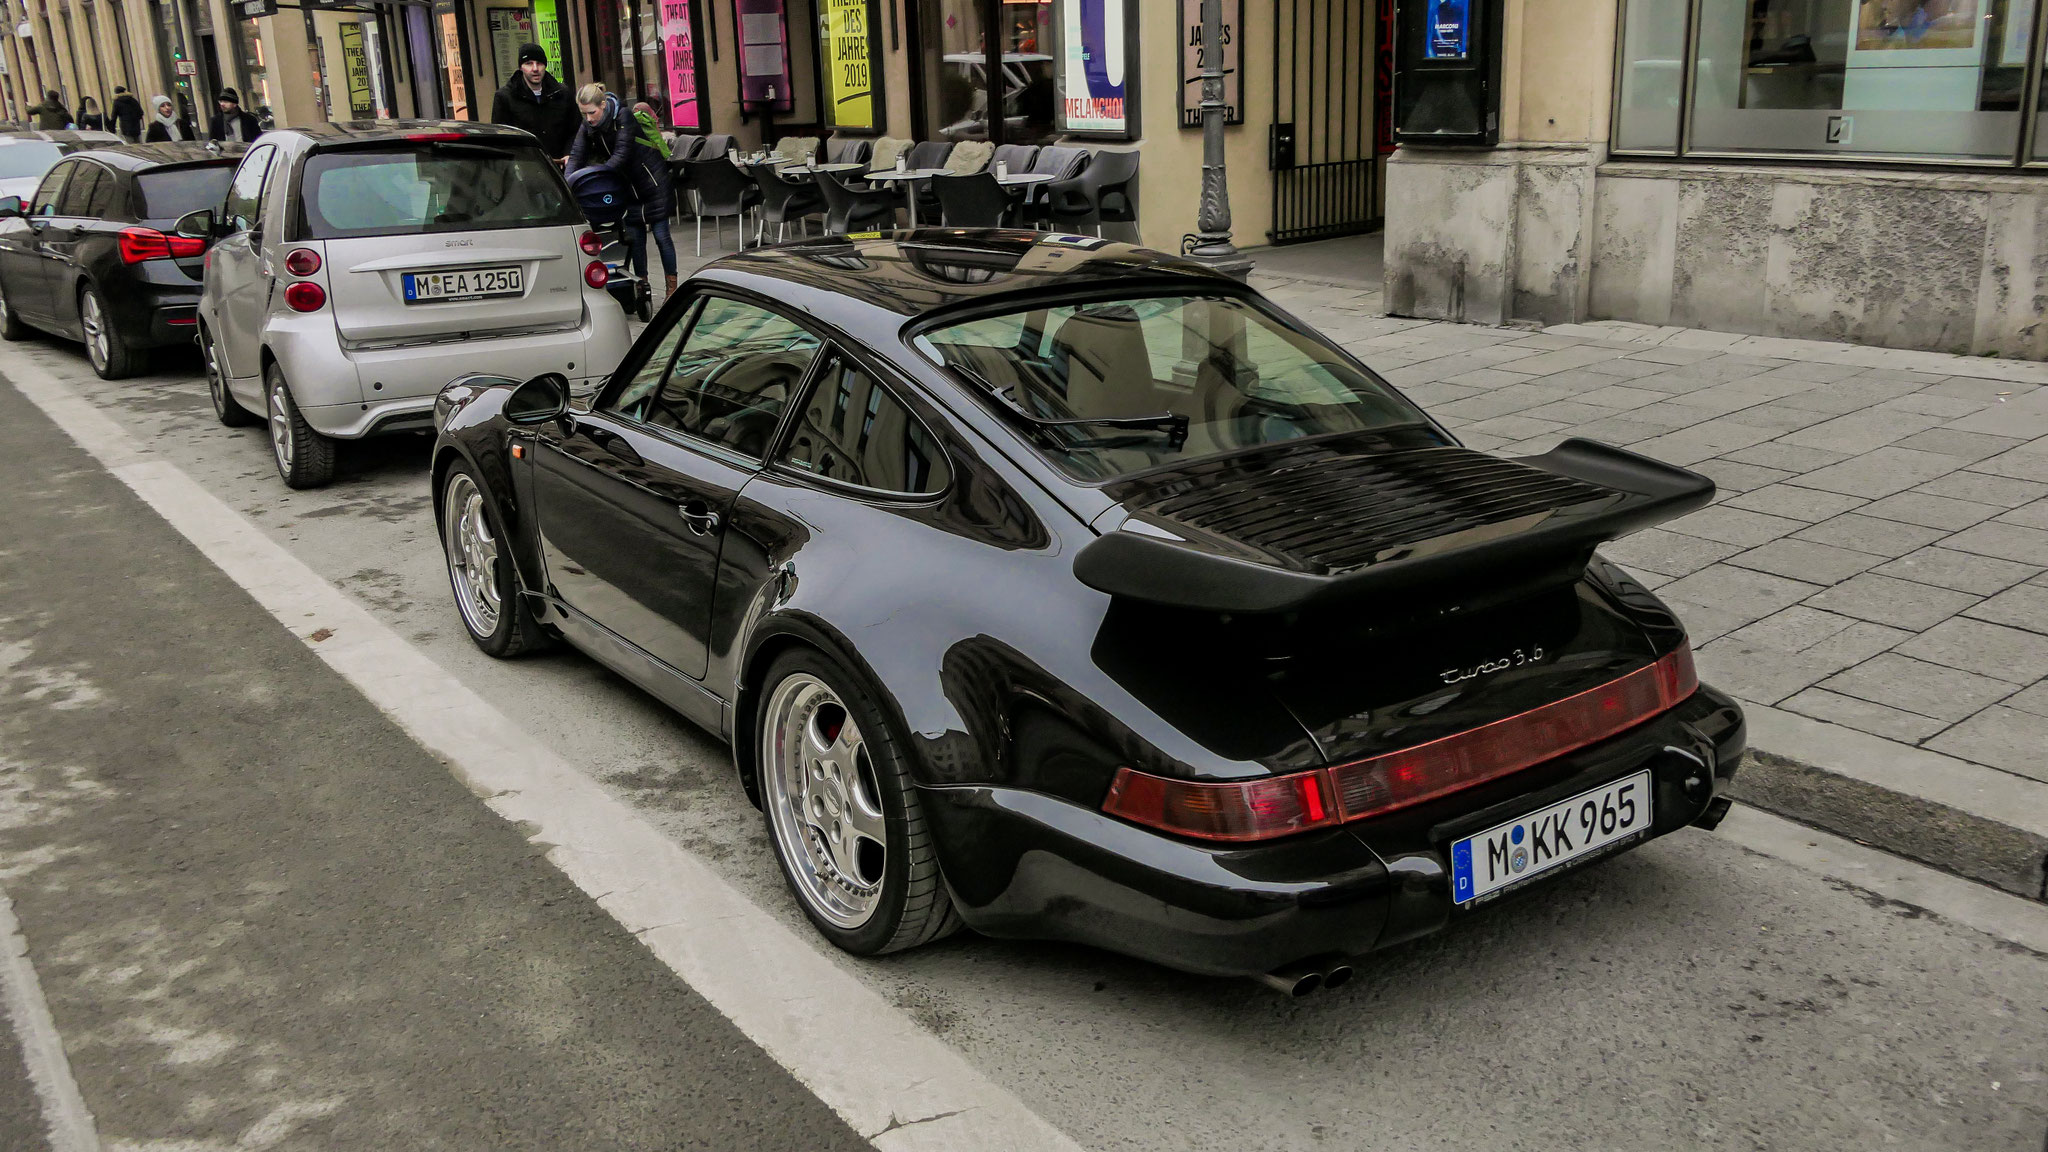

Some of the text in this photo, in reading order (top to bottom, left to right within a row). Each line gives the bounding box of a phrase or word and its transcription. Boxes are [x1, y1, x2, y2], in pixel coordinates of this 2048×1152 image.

[843, 8, 863, 34] DES
[837, 35, 866, 61] JAHRE
[678, 73, 696, 94] 2019
[844, 63, 868, 88] 2019
[445, 238, 474, 248] smart
[416, 270, 520, 296] M EA 1250
[1512, 643, 1543, 667] 3.6
[1488, 783, 1635, 881] M KK 965
[1459, 876, 1468, 890] D
